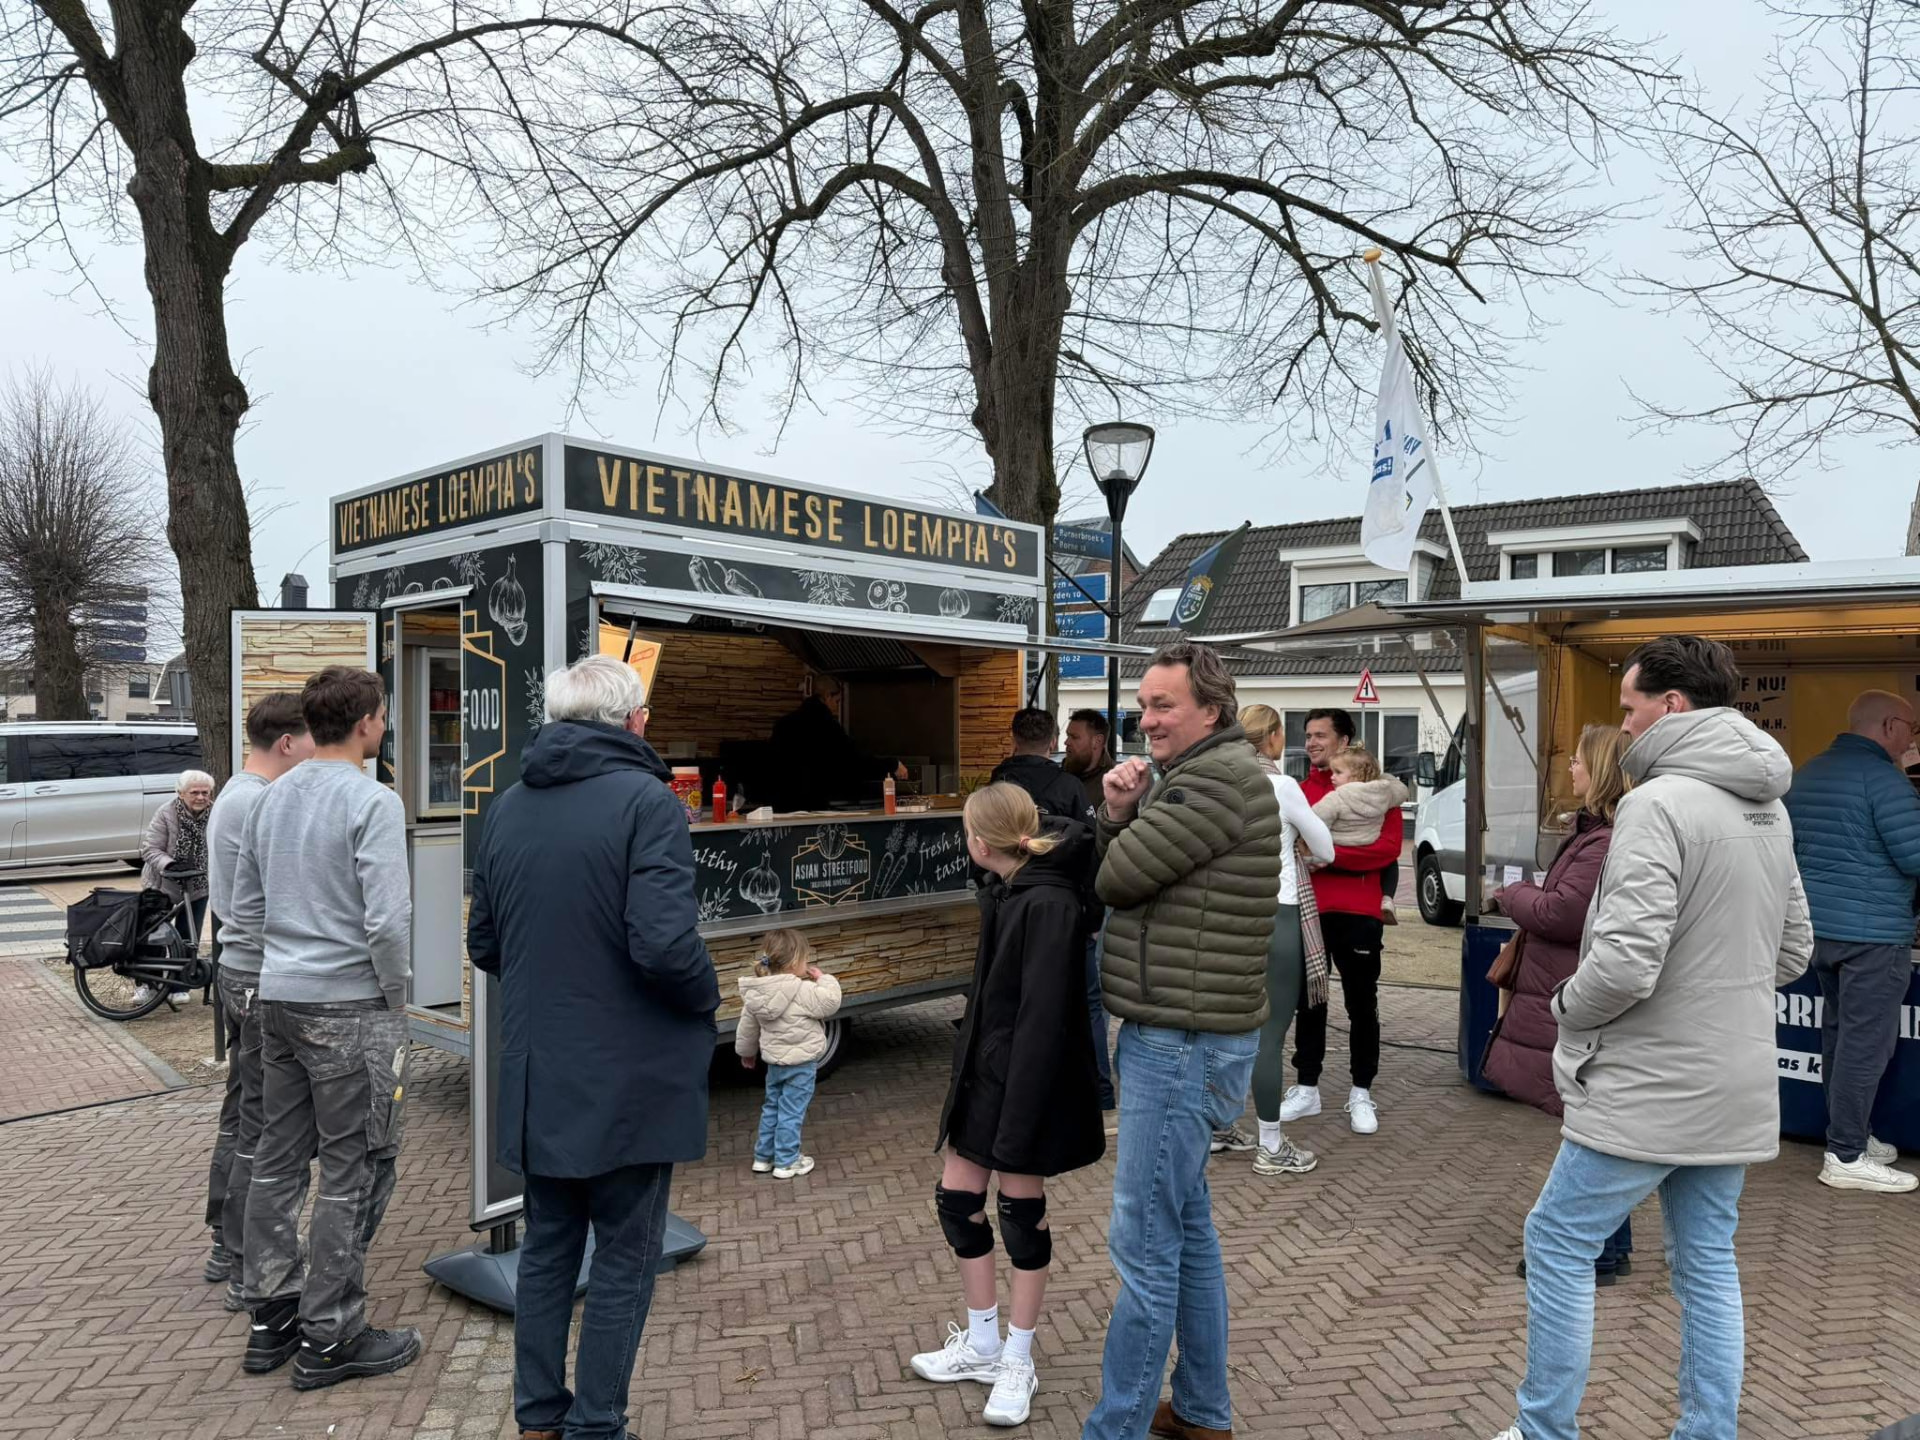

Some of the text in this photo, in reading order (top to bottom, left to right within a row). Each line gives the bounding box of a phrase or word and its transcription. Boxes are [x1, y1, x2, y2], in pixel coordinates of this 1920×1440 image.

[339, 451, 535, 546] VIETNAMESE LOEMPIA'S
[597, 456, 1017, 569] VIETNAMESE LOEMPIA'S
[1757, 676, 1787, 691] NU!
[1761, 718, 1787, 729] N.H.
[918, 831, 951, 876] fresh
[795, 858, 868, 881] ASIAN STREETFOOD
[934, 854, 970, 882] tasty
